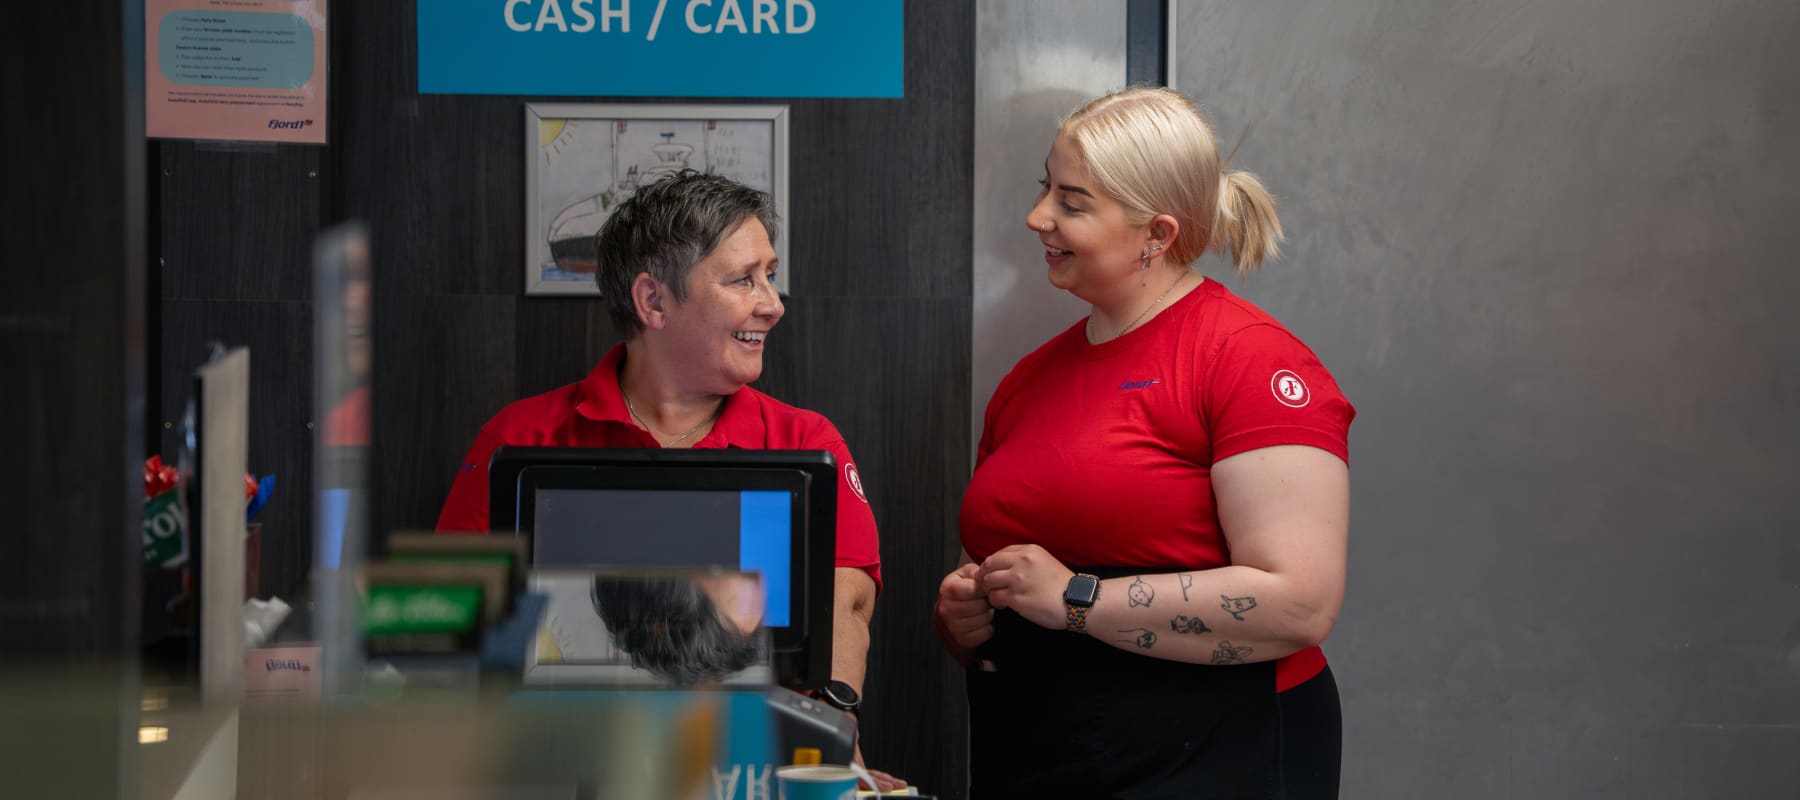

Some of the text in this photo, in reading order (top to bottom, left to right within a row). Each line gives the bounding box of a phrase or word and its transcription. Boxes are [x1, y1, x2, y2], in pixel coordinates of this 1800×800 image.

[503, 0, 817, 41] CASH / CARD
